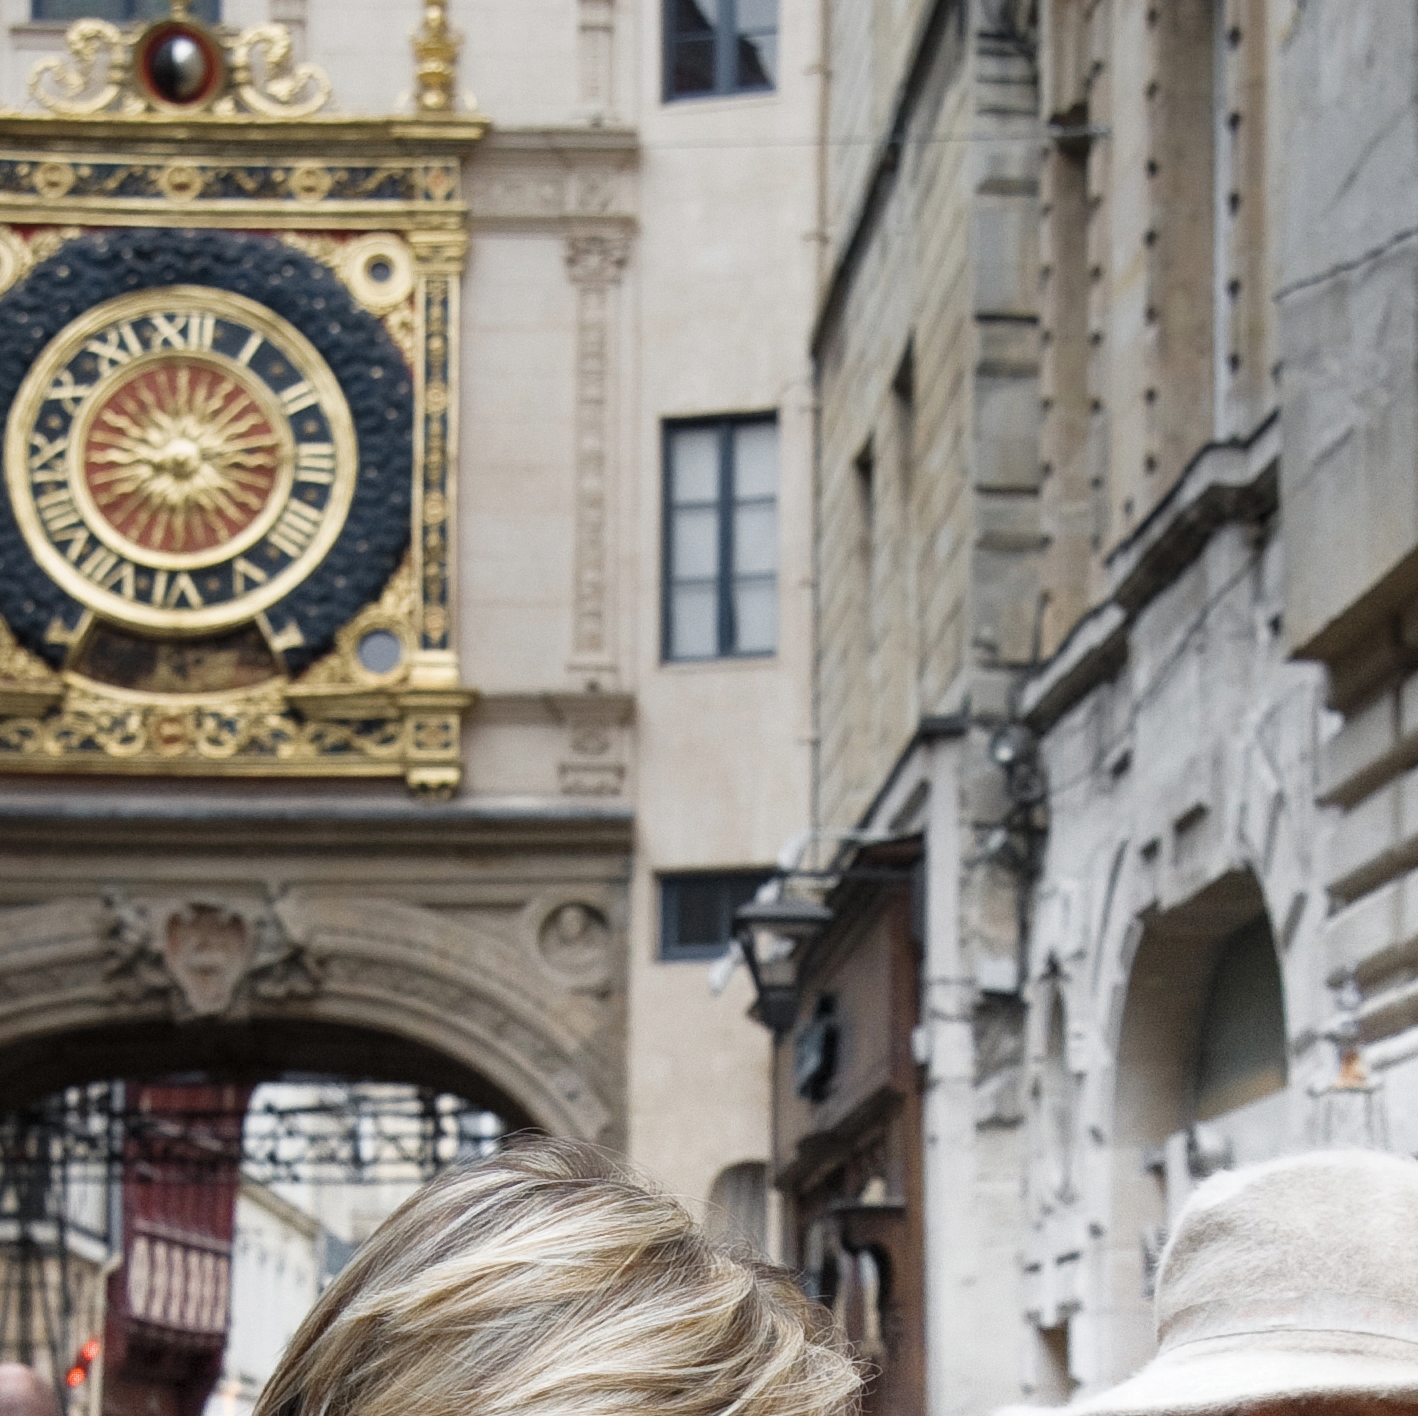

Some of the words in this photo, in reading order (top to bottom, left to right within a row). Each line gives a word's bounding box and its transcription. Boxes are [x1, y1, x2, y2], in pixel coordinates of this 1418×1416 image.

[84, 321, 144, 377] XI
[150, 311, 215, 351] XII
[237, 329, 265, 367] I
[44, 368, 94, 417] X
[279, 380, 322, 417] II
[294, 442, 336, 485] III
[80, 547, 138, 601] VII
[151, 571, 205, 611] VI
[233, 556, 269, 596] V
